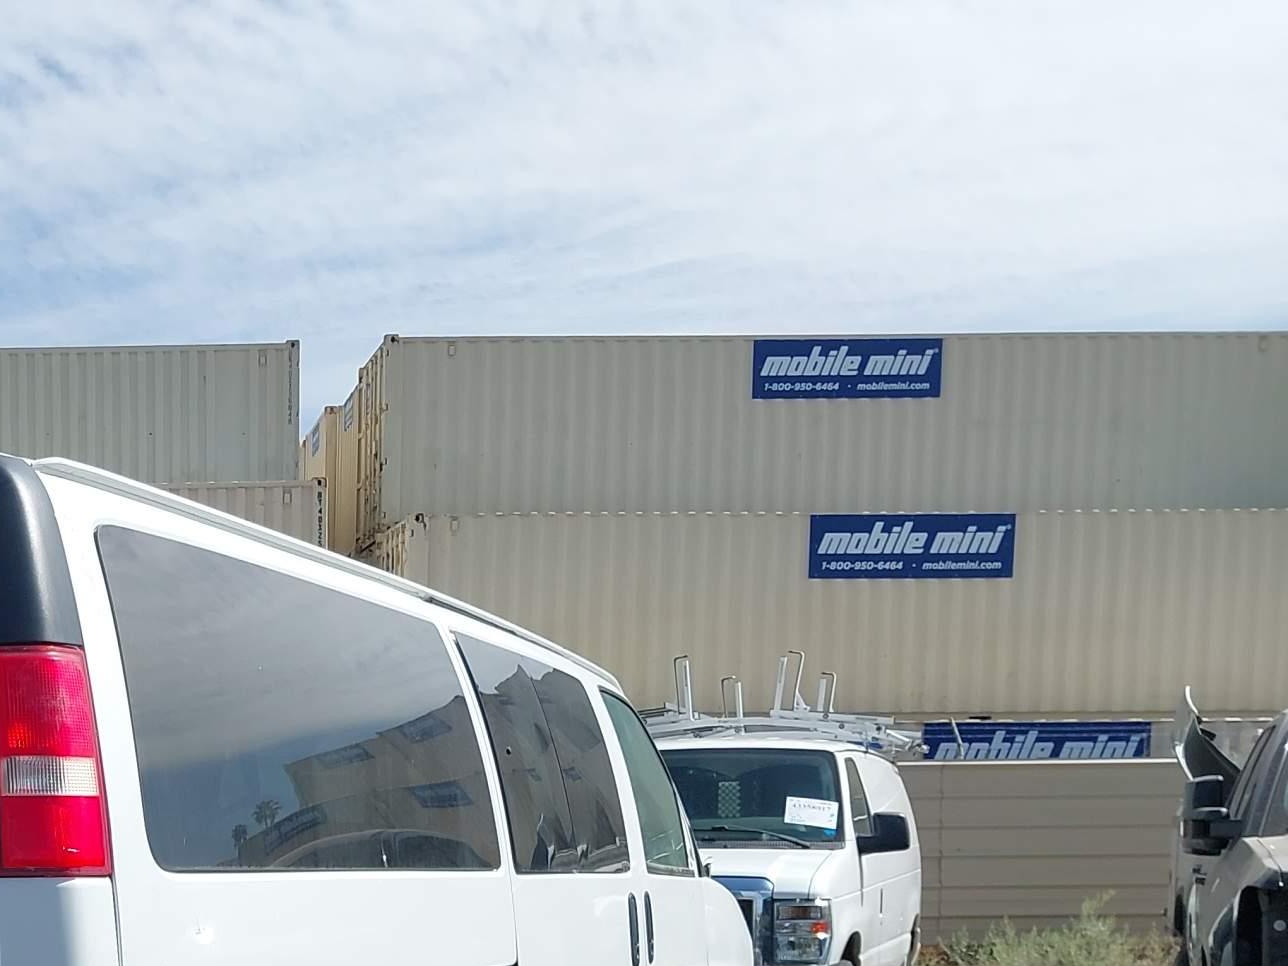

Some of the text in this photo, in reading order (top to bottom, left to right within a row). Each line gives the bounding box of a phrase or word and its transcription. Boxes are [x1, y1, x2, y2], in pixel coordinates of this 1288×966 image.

[760, 345, 935, 377] mobile mini
[764, 381, 930, 391] 1-800-950-6464 mobilemini.com
[816, 521, 1006, 555] mobile mini
[821, 559, 1002, 571] 1-800-950-6464 mobilemini.com
[1057, 734, 1141, 760] mini
